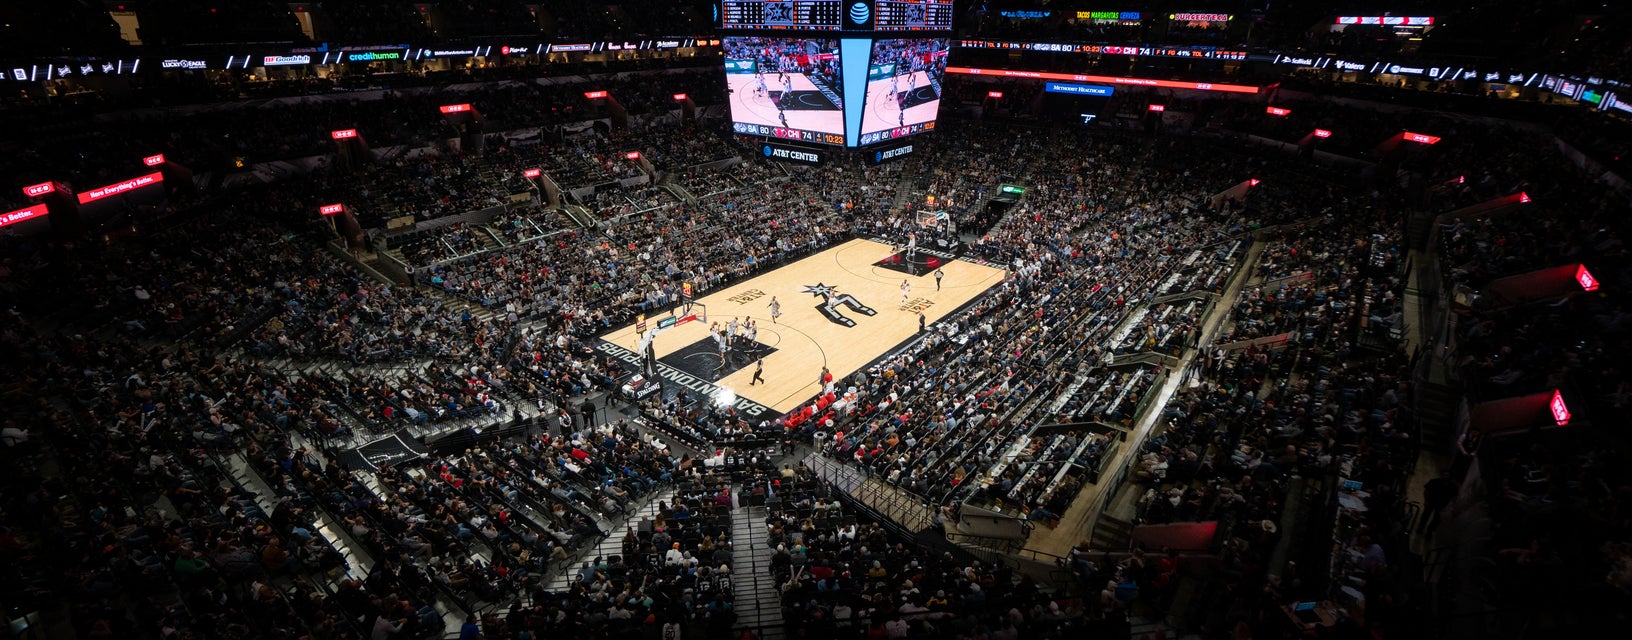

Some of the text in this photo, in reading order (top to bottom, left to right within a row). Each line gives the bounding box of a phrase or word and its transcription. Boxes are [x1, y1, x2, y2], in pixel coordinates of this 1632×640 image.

[1091, 11, 1119, 19] MARGARITAS
[1175, 12, 1227, 21] BURGERTECA
[1062, 44, 1072, 52] 80
[349, 52, 399, 60] credithuman
[747, 125, 757, 133] SA
[760, 126, 769, 134] 80
[788, 130, 800, 139] CHI
[825, 135, 844, 144] 10:23
[872, 133, 879, 141] SA
[901, 127, 910, 135] CHI
[911, 125, 917, 133] 74
[773, 148, 818, 162] AT&T CENTER
[882, 145, 913, 160] AT&T CENTER
[90, 190, 104, 198] Here
[104, 179, 137, 195] Everything's
[8, 209, 34, 221] Better.
